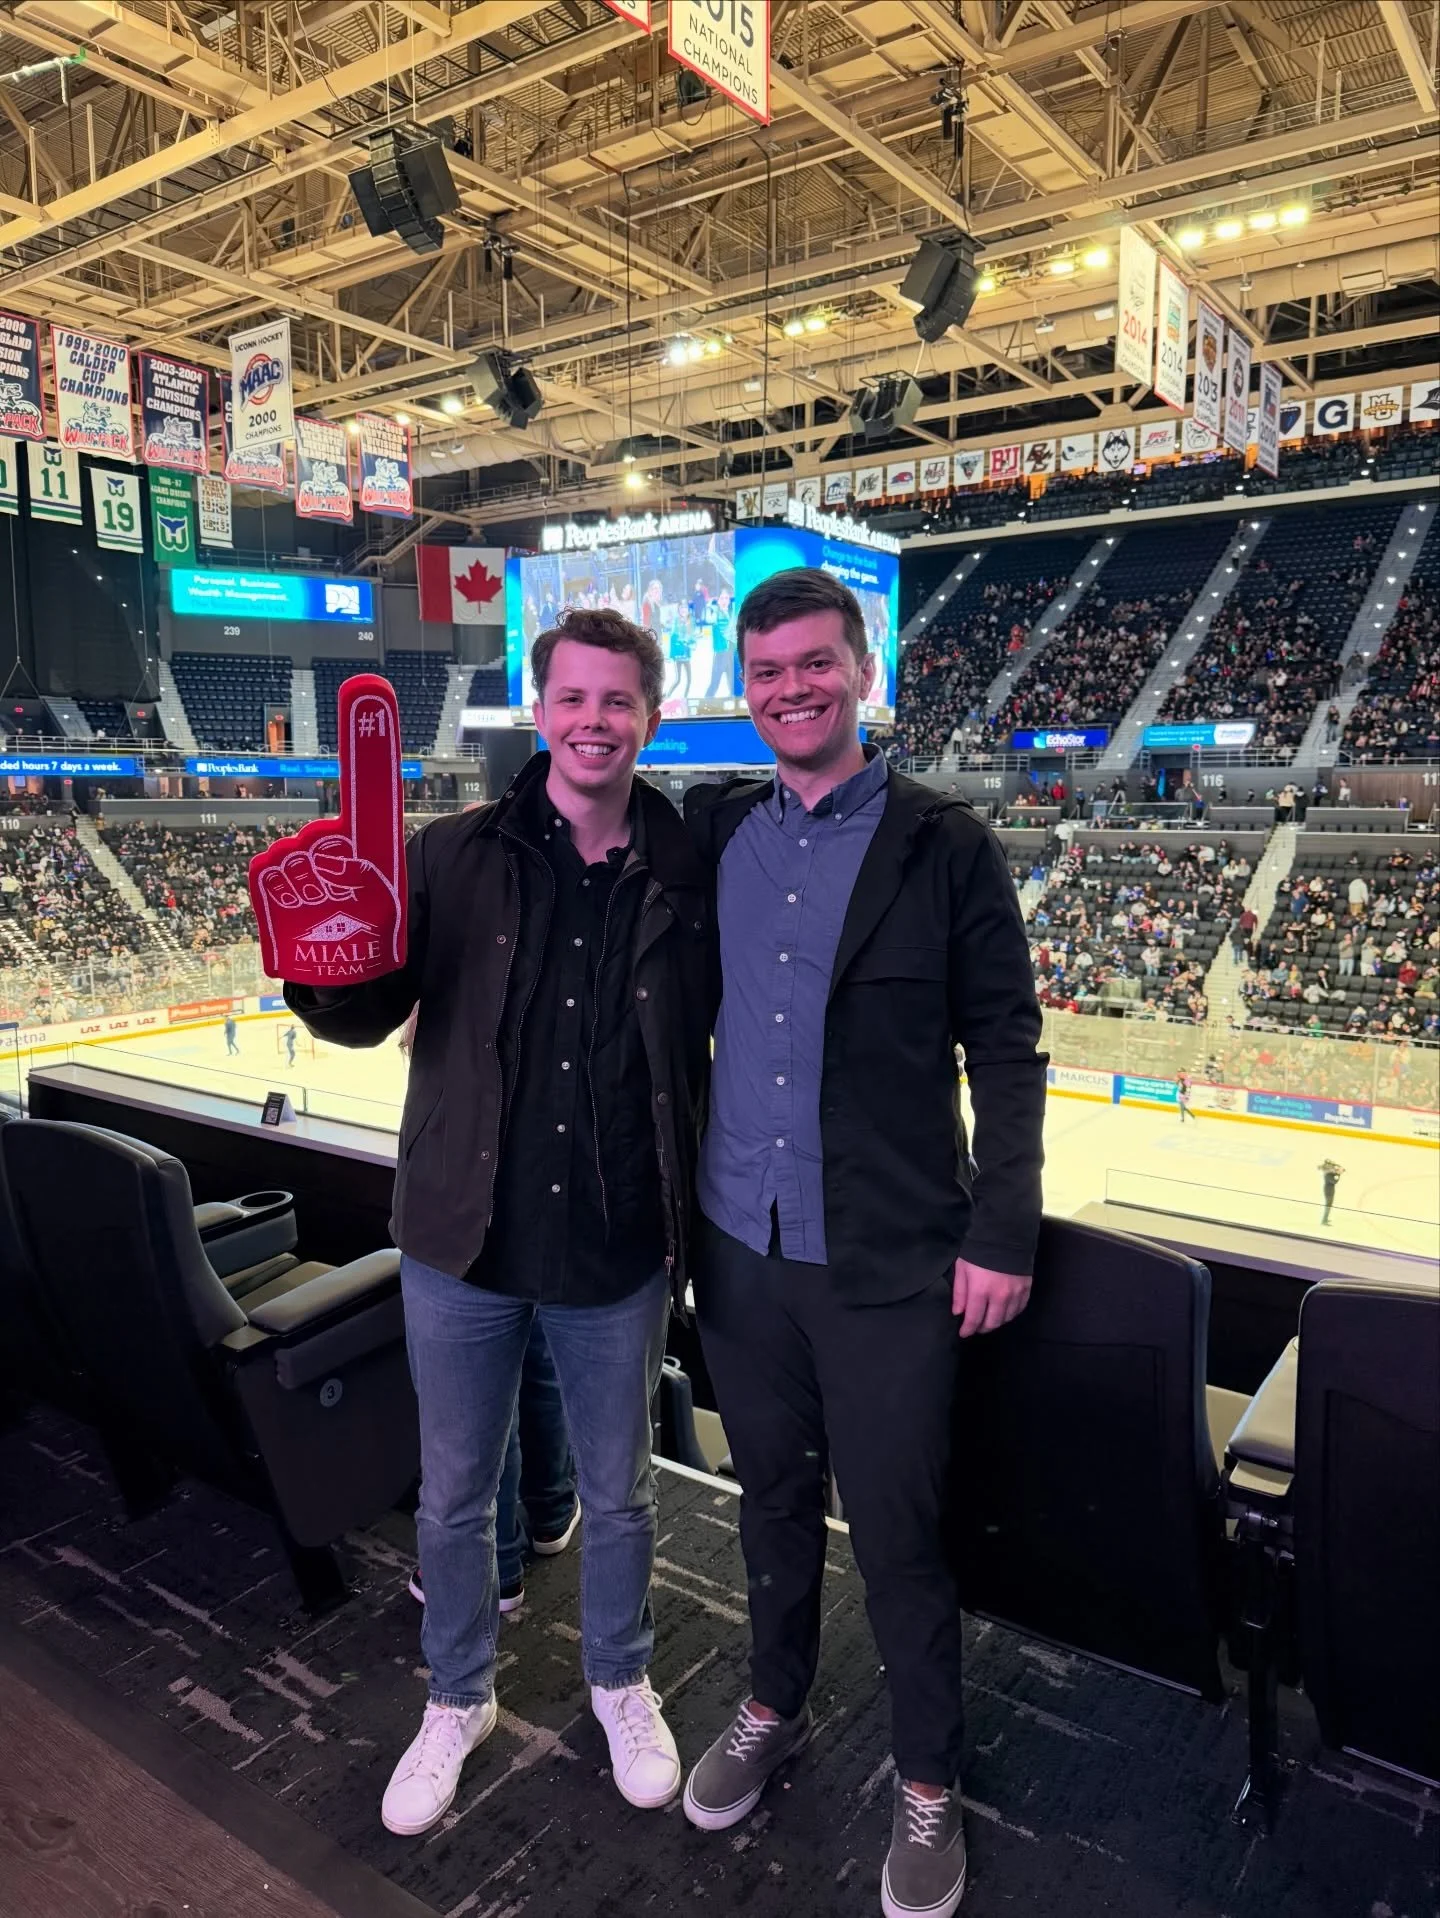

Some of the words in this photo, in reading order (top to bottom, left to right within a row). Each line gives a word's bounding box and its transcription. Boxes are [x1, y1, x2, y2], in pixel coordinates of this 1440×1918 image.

[689, 0, 755, 48] 015
[689, 14, 753, 76] NATIONAL
[683, 38, 758, 105] CHAMPIONS
[1123, 309, 1148, 347] 2014
[58, 332, 126, 363] 1999-2000
[235, 340, 257, 352] UCONN
[258, 331, 284, 346] HOCKEY
[69, 350, 116, 374] CALDER
[1161, 342, 1183, 376] 2014
[82, 369, 106, 384] CUP
[150, 358, 203, 384] 2003-2004
[239, 358, 282, 399] MAAC
[60, 377, 129, 406] CHAMPIONS
[152, 373, 200, 395] ATLANTIC
[154, 388, 196, 408] DIVISION
[146, 397, 201, 421] CHAMPIONS
[248, 410, 277, 427] 2000
[1318, 400, 1348, 429] G
[245, 425, 282, 440] CHAMPIONS
[1144, 436, 1173, 446] EAST
[992, 447, 1019, 473] BU
[40, 467, 69, 500] 11
[102, 499, 135, 532] 19
[565, 512, 659, 550] PeoplesBank
[659, 509, 714, 535] ARENA
[861, 572, 879, 584] game.
[224, 626, 240, 636] 239
[358, 631, 373, 641] 240
[358, 708, 386, 737] #1
[1046, 733, 1086, 747] EchoStar
[22, 761, 49, 771] hours
[51, 762, 57, 771] 7
[61, 761, 83, 773] days
[92, 762, 122, 771] week.
[207, 763, 259, 775] PeoplesBank
[464, 782, 480, 792] 112
[669, 780, 683, 790] 113
[983, 777, 1001, 789] 115
[1202, 774, 1224, 787] 116
[1422, 772, 1440, 786] 11
[1, 818, 20, 830] 110
[201, 813, 217, 824] 111
[295, 940, 380, 963] MIALE
[313, 963, 364, 976] TEAM
[80, 1025, 102, 1035] LAZ
[109, 1021, 129, 1030] LAZ
[137, 1017, 156, 1026] LAZ
[1060, 1071, 1109, 1086] MARCUS
[327, 1384, 336, 1400] 3
